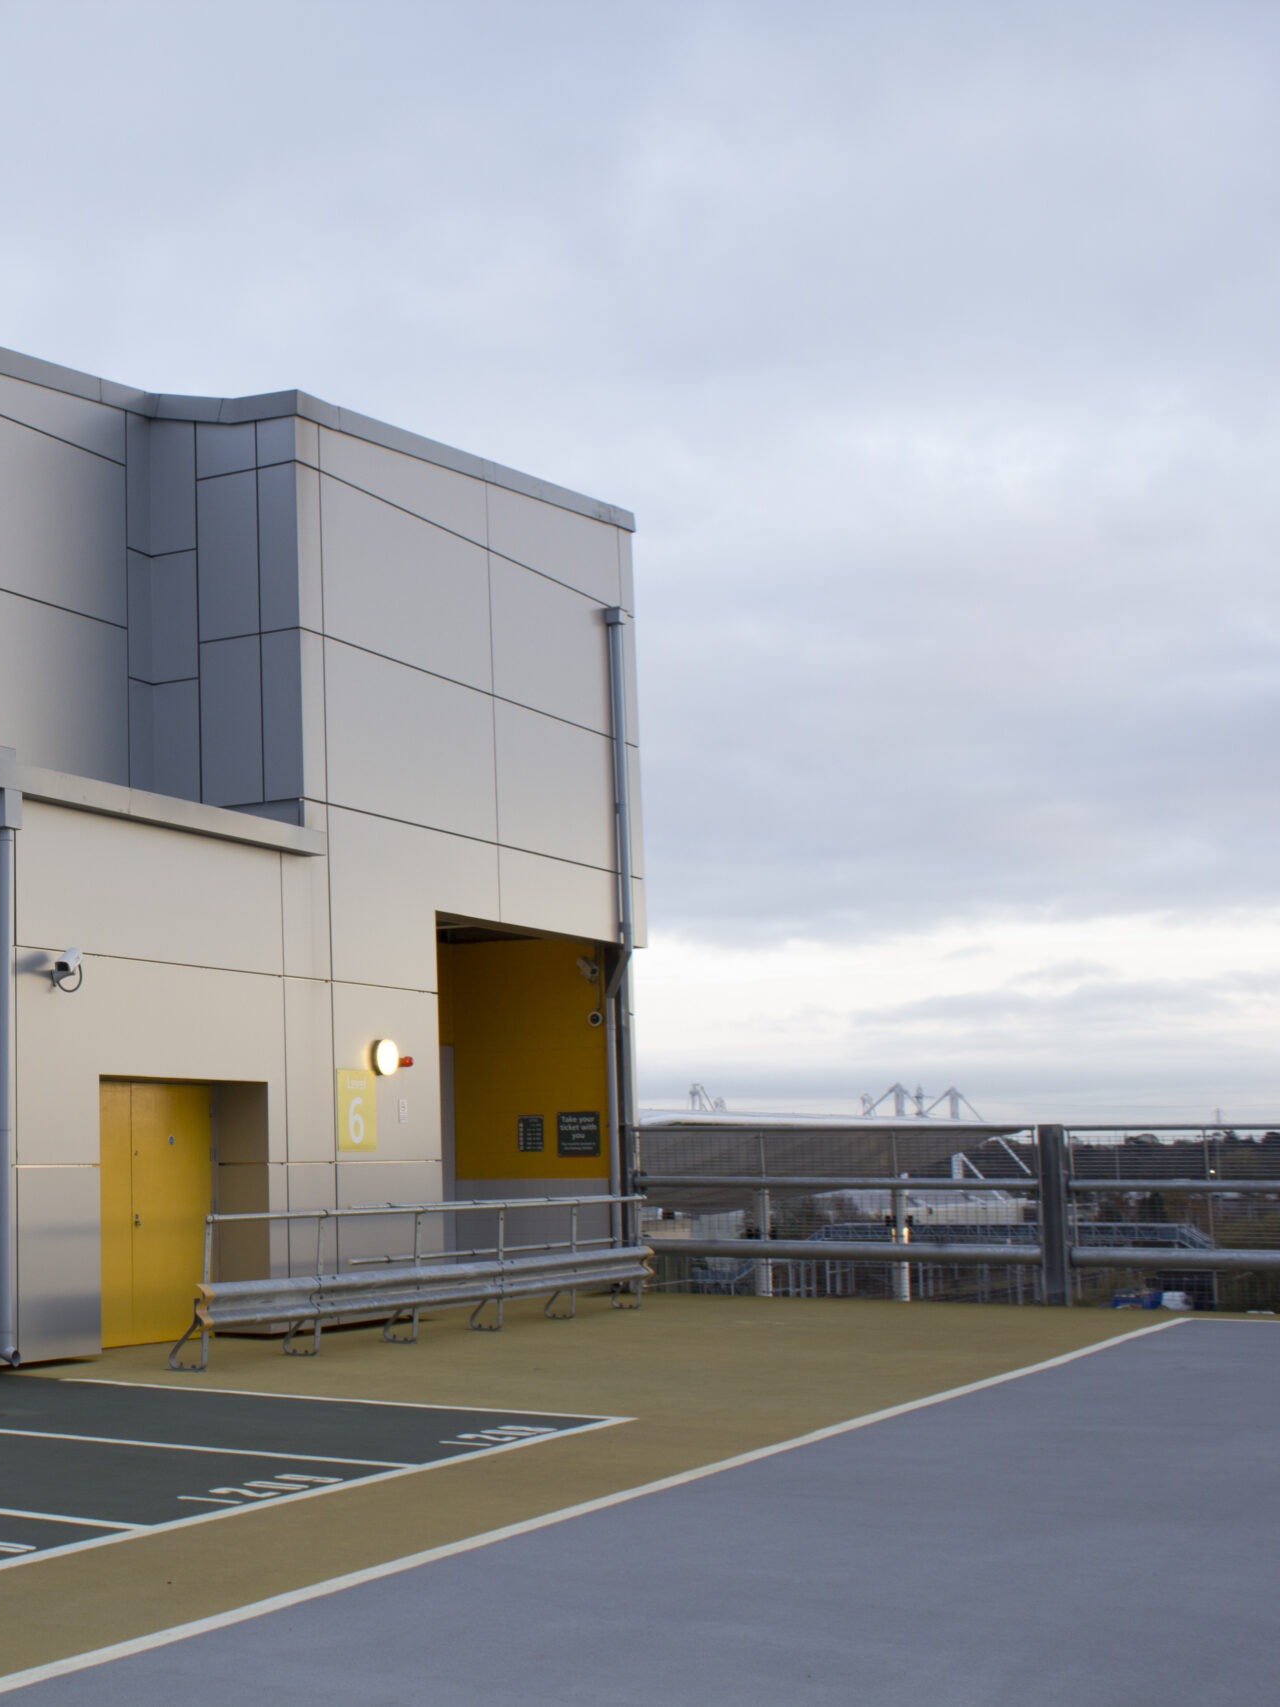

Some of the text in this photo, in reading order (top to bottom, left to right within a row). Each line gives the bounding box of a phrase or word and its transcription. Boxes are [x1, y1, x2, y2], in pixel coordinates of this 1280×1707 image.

[346, 1075, 367, 1090] Level
[348, 1096, 365, 1144] 6
[560, 1115, 595, 1124] Take your
[560, 1123, 597, 1131] ticket with
[571, 1133, 585, 1141] you
[176, 1473, 344, 1504] 1209
